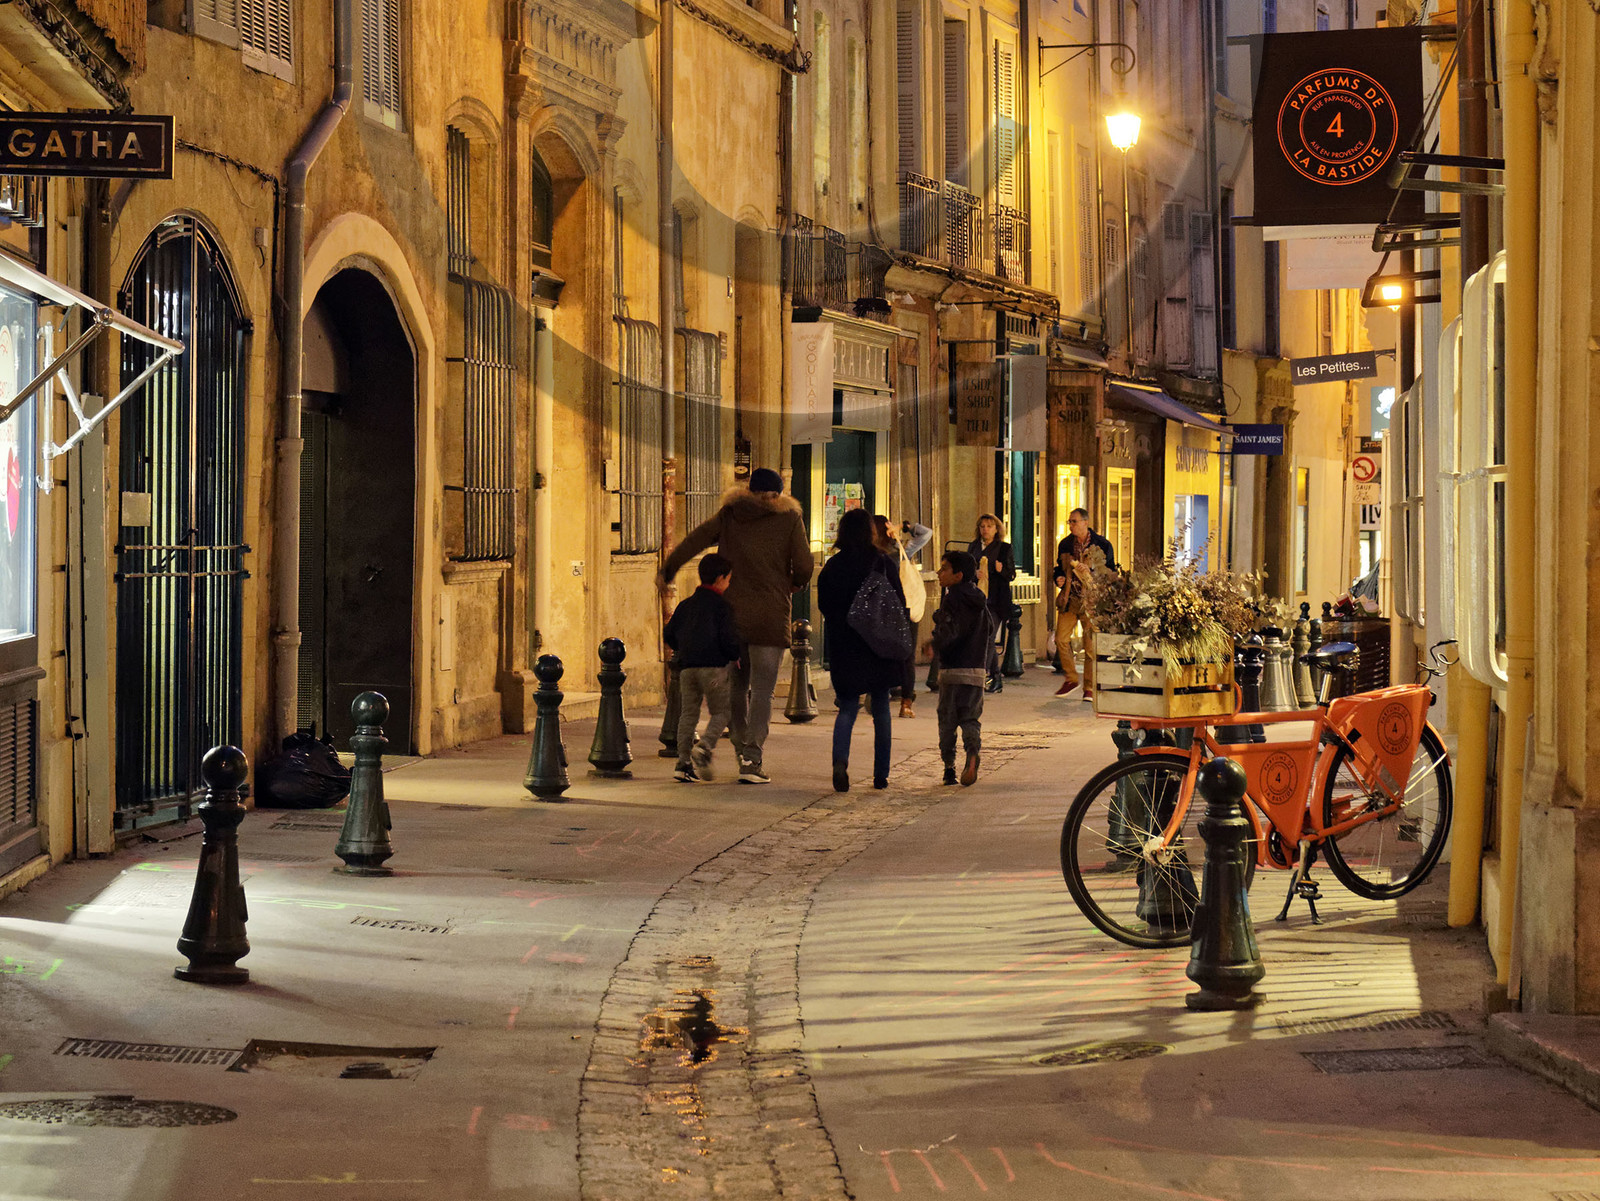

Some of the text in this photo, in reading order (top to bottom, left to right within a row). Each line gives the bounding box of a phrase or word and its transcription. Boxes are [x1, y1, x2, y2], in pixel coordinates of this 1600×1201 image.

[1290, 76, 1385, 110] PARFUMS DE
[1311, 95, 1363, 112] RUE PAPASSAUDI
[1326, 111, 1344, 138] 4
[0, 128, 145, 160] GATHA
[1309, 140, 1365, 159] AIX EN PROVENCE
[1294, 146, 1383, 178] LA BASTIDE
[833, 338, 886, 383] BRAIRIE
[1297, 361, 1370, 377] Les Petites...
[806, 341, 817, 421] GOULARD
[1058, 409, 1089, 423] SHOP
[1235, 435, 1281, 444] SAINT JAMES
[1392, 722, 1397, 733] 4
[1275, 772, 1281, 783] 4
